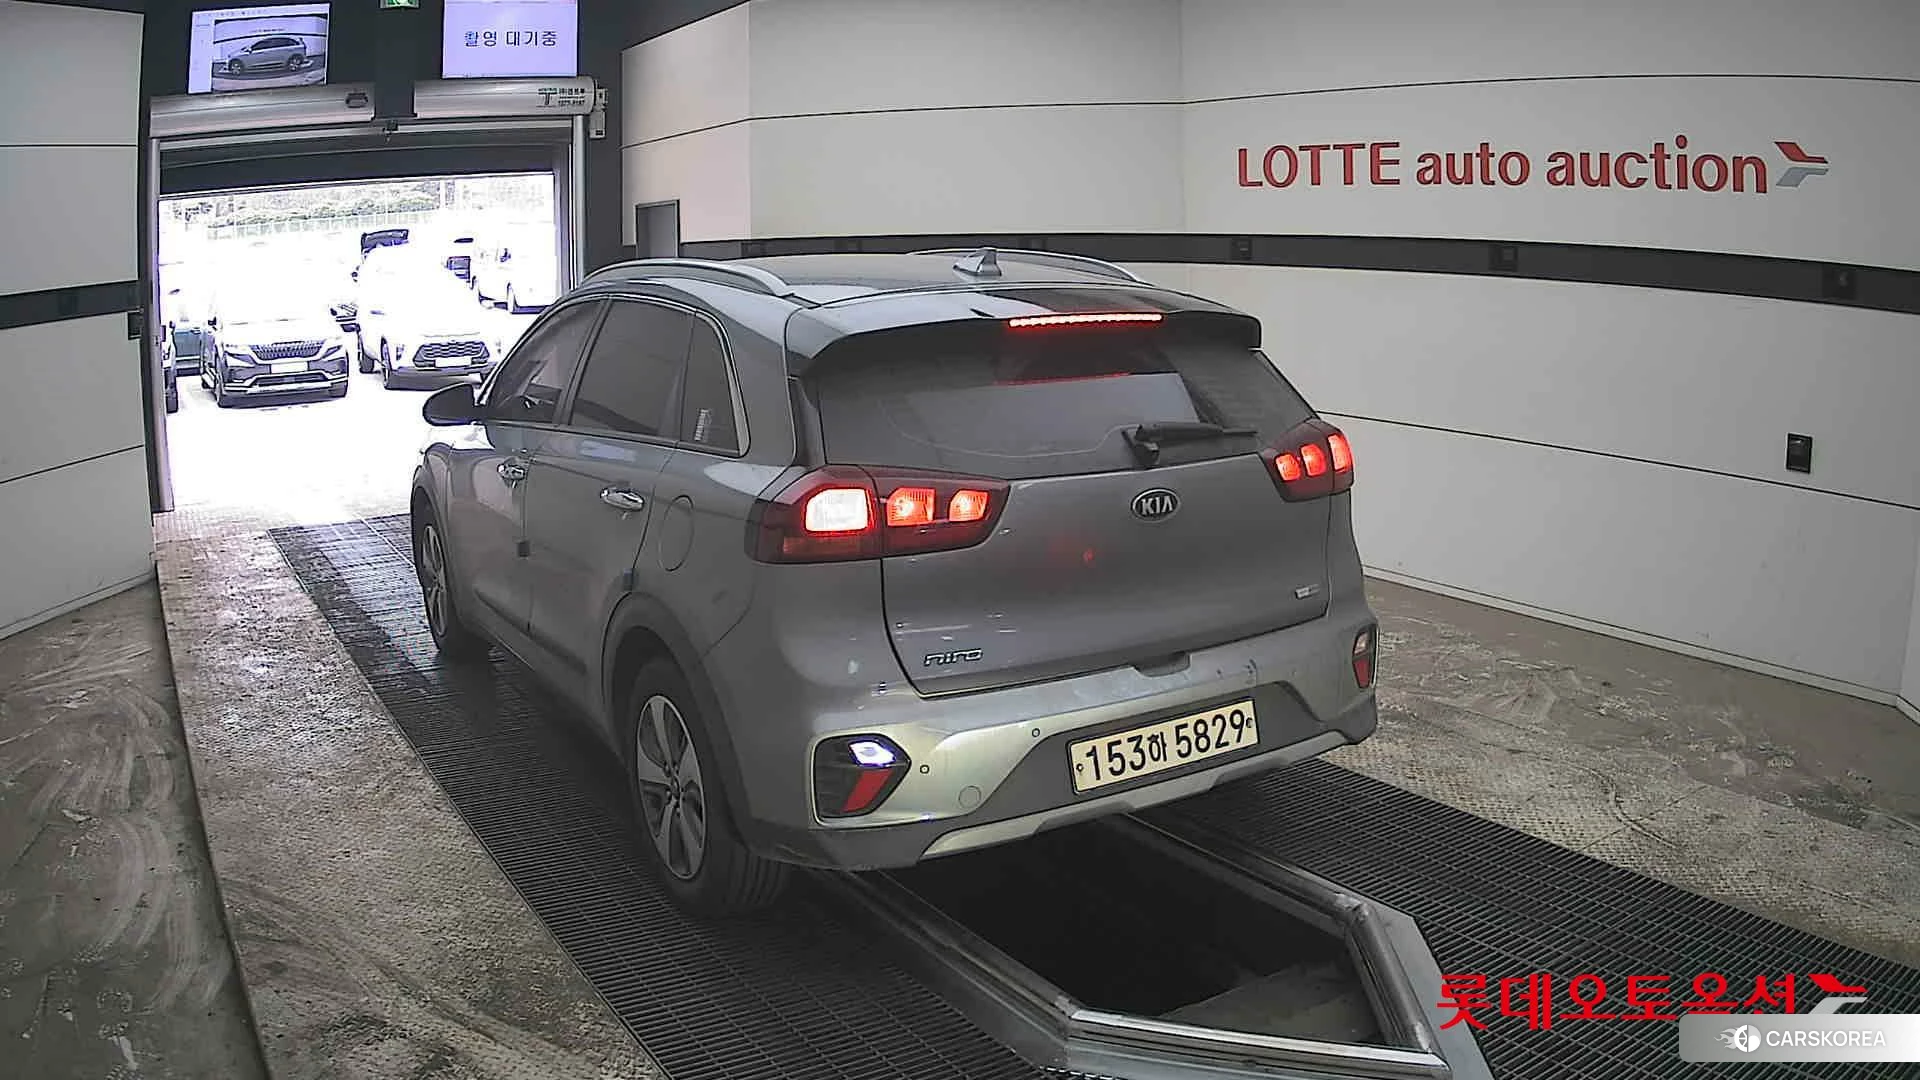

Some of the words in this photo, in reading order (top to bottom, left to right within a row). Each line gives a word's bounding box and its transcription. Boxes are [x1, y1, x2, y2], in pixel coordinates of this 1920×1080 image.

[505, 31, 557, 47] 대기중
[1237, 142, 1400, 188] LOTTE
[1416, 142, 1530, 187] auto
[1546, 135, 1768, 194] auction
[1141, 496, 1173, 515] KIA
[1086, 732, 1168, 781] 153하
[1174, 709, 1245, 758] 5829
